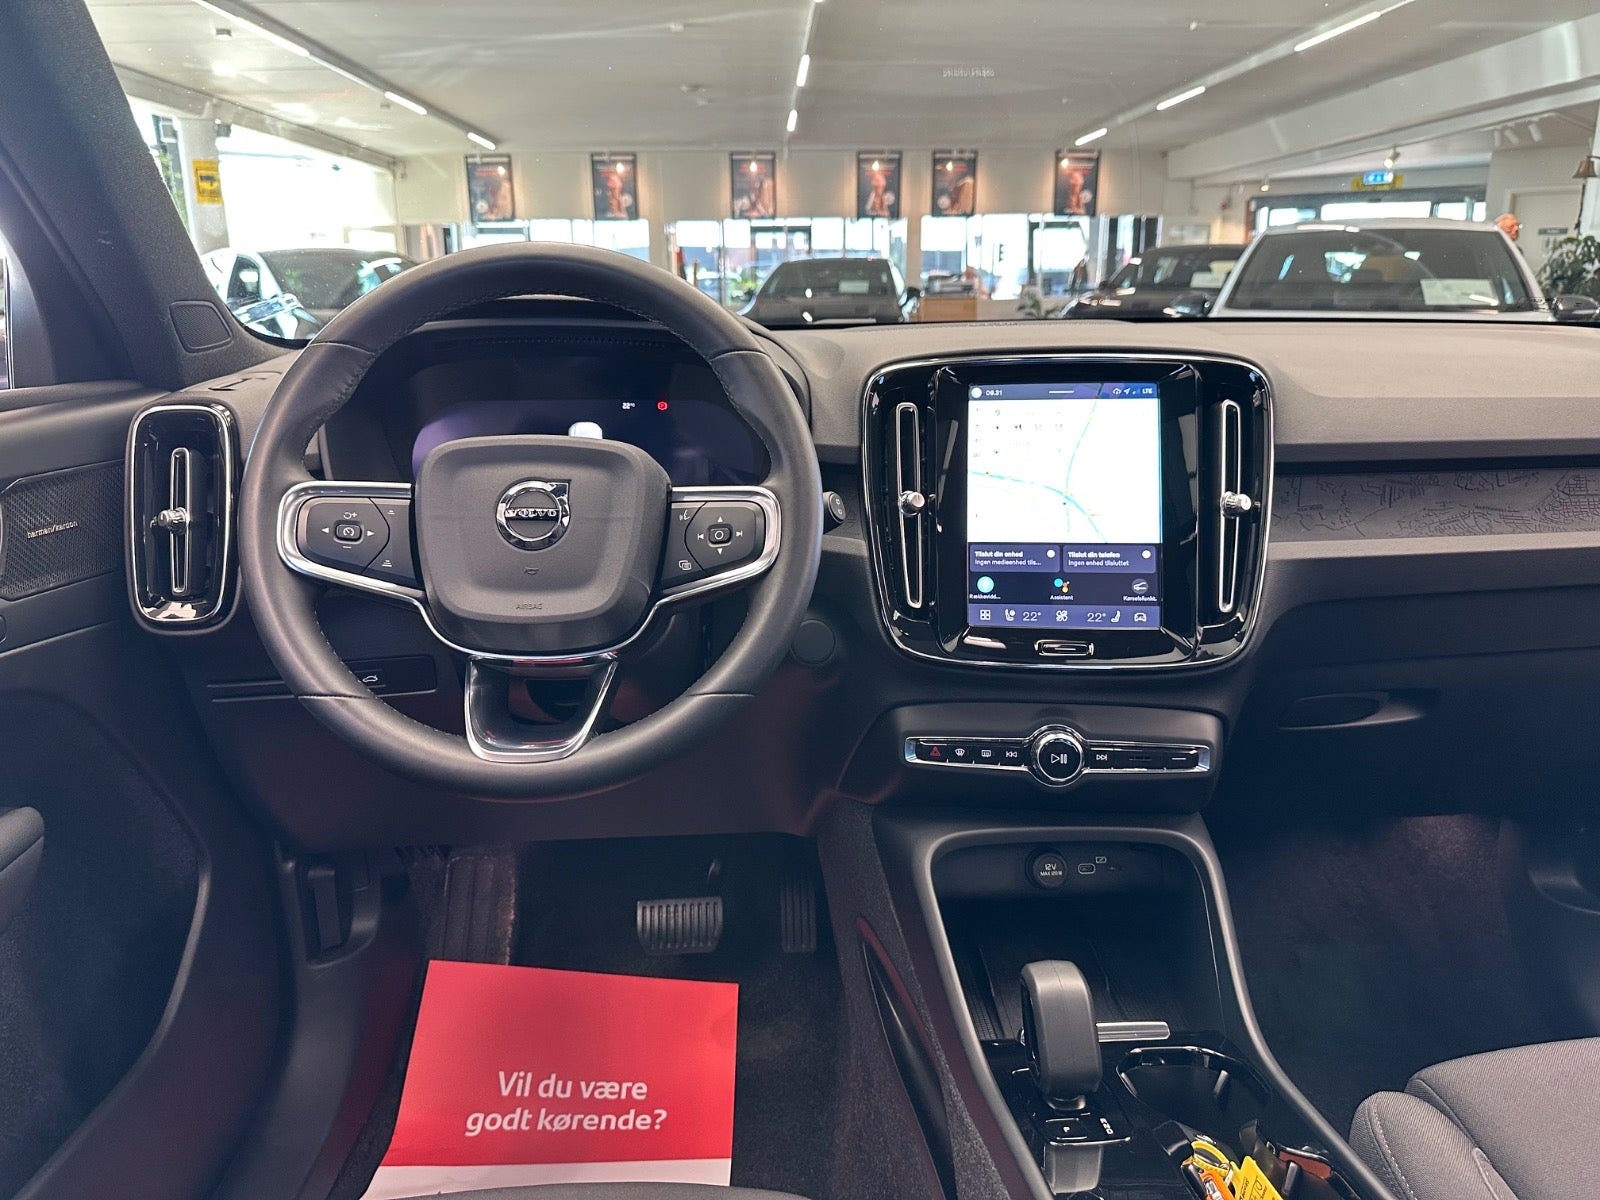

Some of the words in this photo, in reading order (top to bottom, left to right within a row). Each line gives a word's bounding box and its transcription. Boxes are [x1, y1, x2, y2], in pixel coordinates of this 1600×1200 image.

[505, 509, 557, 518] VOLVO
[1022, 611, 1042, 622] 22°
[1087, 612, 1107, 623] 22°
[1045, 863, 1057, 871] 12V
[498, 1070, 533, 1098] Vil
[537, 1073, 572, 1099] du
[580, 1080, 649, 1100] være
[464, 1107, 533, 1137] godt
[536, 1107, 668, 1132] kørende?
